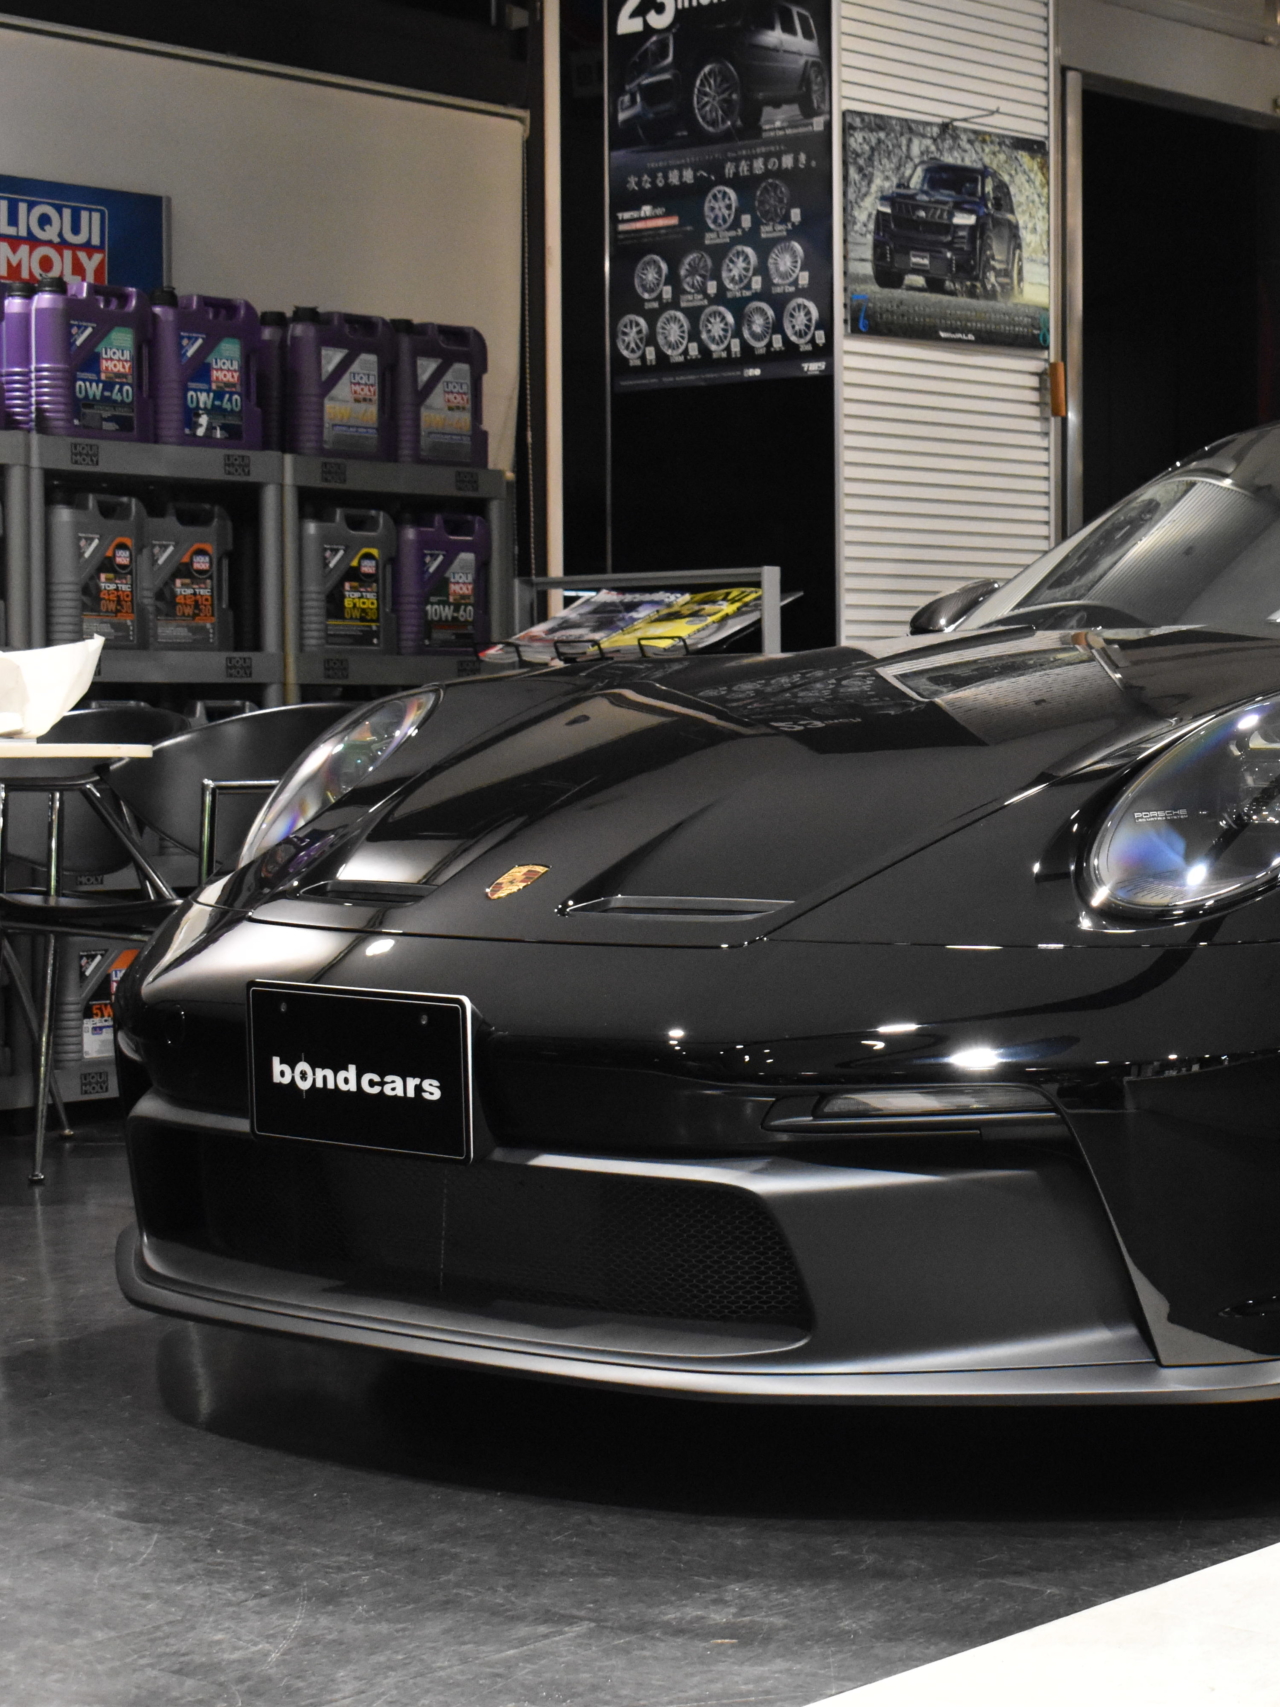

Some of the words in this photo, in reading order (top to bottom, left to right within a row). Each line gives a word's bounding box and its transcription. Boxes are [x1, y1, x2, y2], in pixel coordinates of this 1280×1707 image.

[0, 199, 101, 246] LIQUI
[0, 241, 104, 284] MOLY
[102, 348, 130, 360] LIQUI
[102, 361, 131, 372] MOLY
[213, 358, 238, 370] LIQUI
[213, 370, 239, 382] MOLY
[351, 373, 376, 385] LIQUI
[76, 381, 132, 403] 0W-40
[351, 384, 376, 396] MOLY
[444, 381, 468, 393] LIQUI
[187, 391, 241, 412] 0W-40
[445, 392, 469, 404] MOLY
[72, 444, 98, 454] LIQUI
[72, 454, 98, 465] MOLY
[450, 572, 473, 583] LIQUI
[450, 583, 474, 594] MOLY
[100, 590, 132, 601] 4210
[175, 595, 212, 605] 4210
[101, 600, 132, 613] 0W-30
[344, 598, 378, 608] 6100
[177, 604, 212, 616] 0W-30
[425, 604, 474, 622] 10W-60
[1134, 809, 1187, 818] PORSCHE
[92, 1004, 114, 1019] 5W
[82, 1073, 107, 1083] LIQUI
[82, 1083, 107, 1094] MOLY
